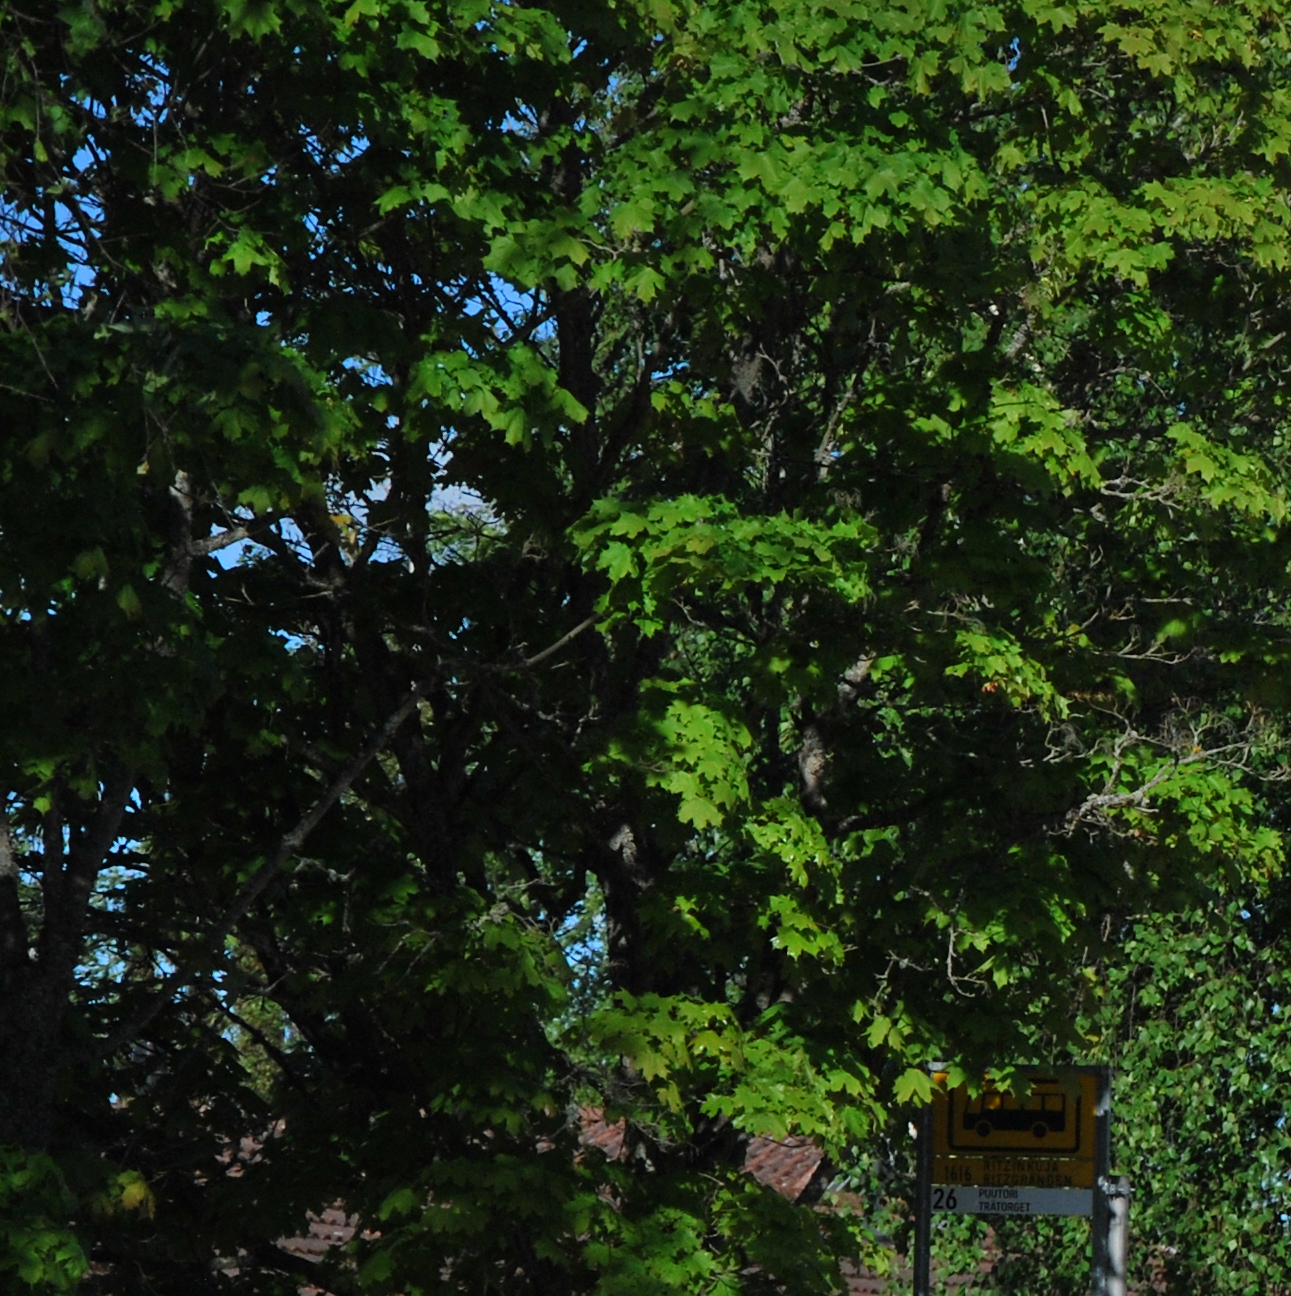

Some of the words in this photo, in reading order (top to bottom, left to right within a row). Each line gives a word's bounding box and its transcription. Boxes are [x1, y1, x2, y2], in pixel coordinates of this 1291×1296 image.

[945, 1165, 972, 1182] 1616
[933, 1188, 957, 1209] 26
[978, 1188, 1018, 1199] PUUTORI
